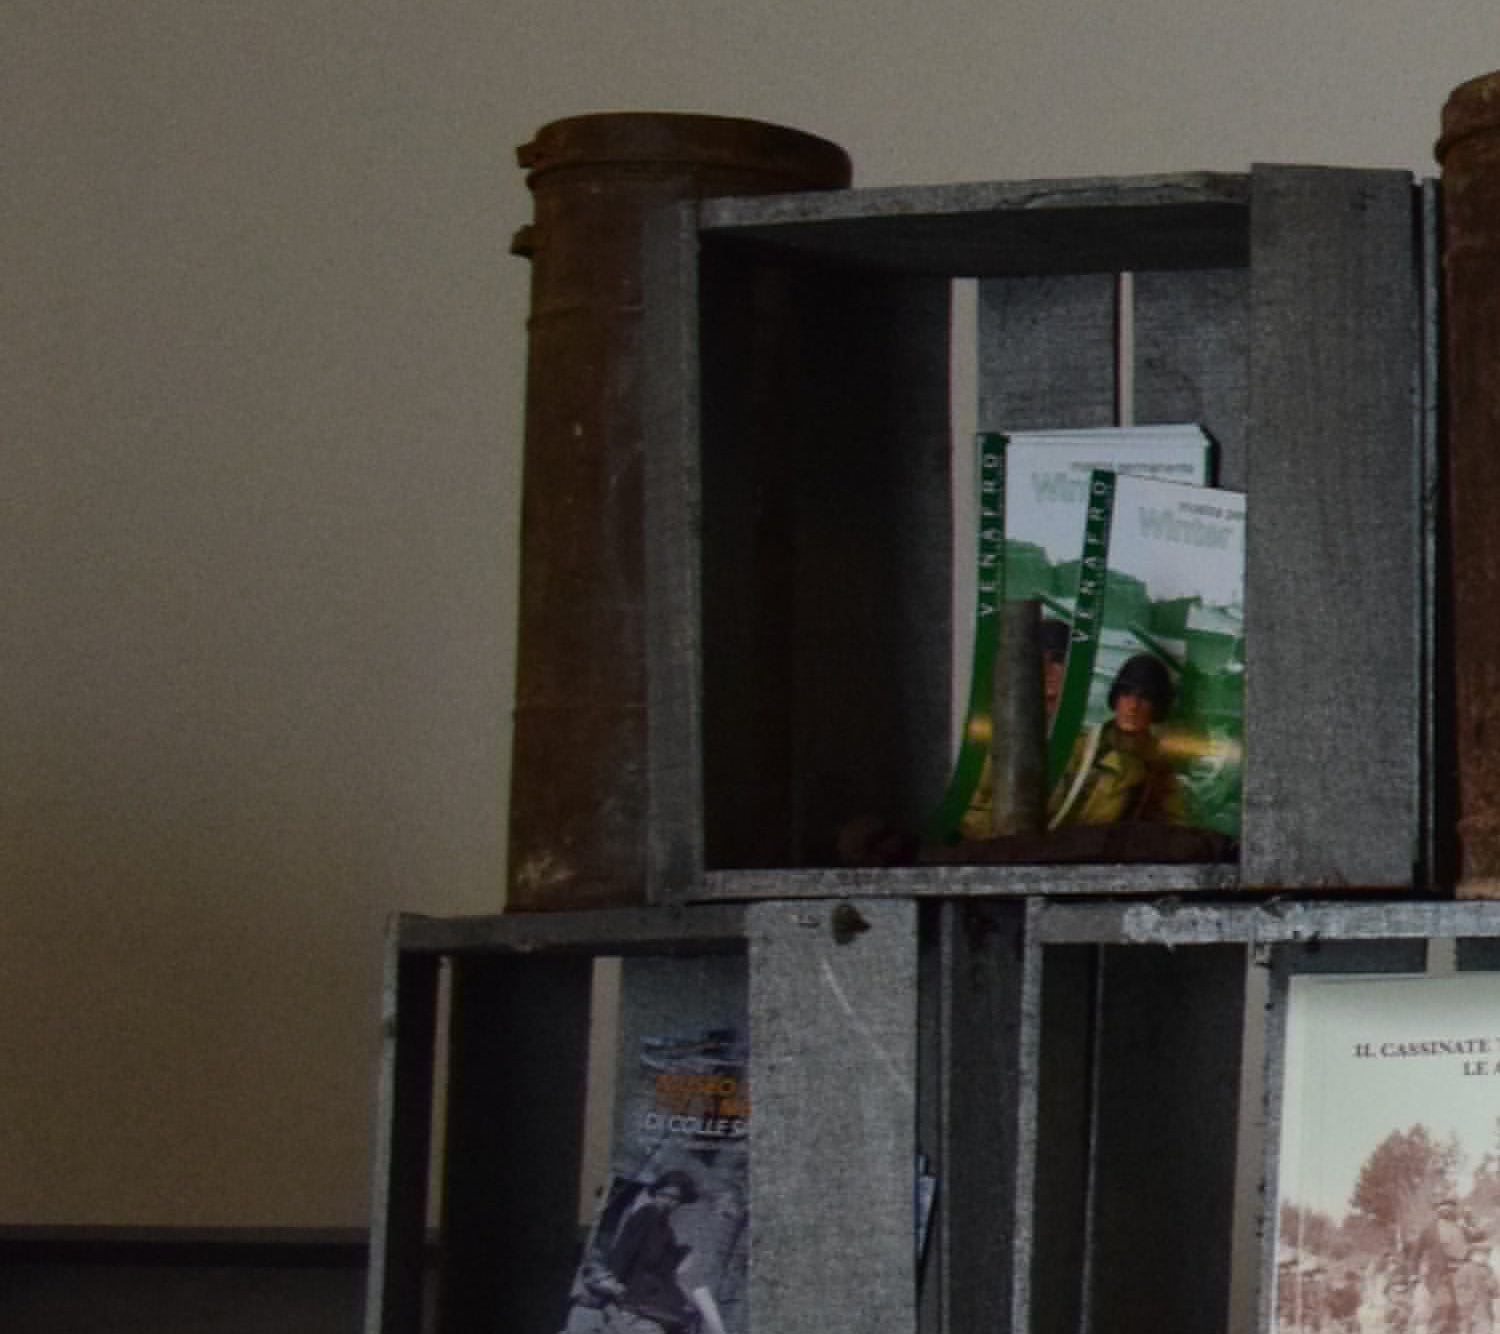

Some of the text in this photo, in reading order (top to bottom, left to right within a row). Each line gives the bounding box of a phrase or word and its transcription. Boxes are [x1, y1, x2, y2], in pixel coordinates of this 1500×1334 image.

[1353, 1042, 1377, 1058] IL
[1380, 1038, 1488, 1058] CASSINATE
[1463, 1060, 1488, 1076] LE
